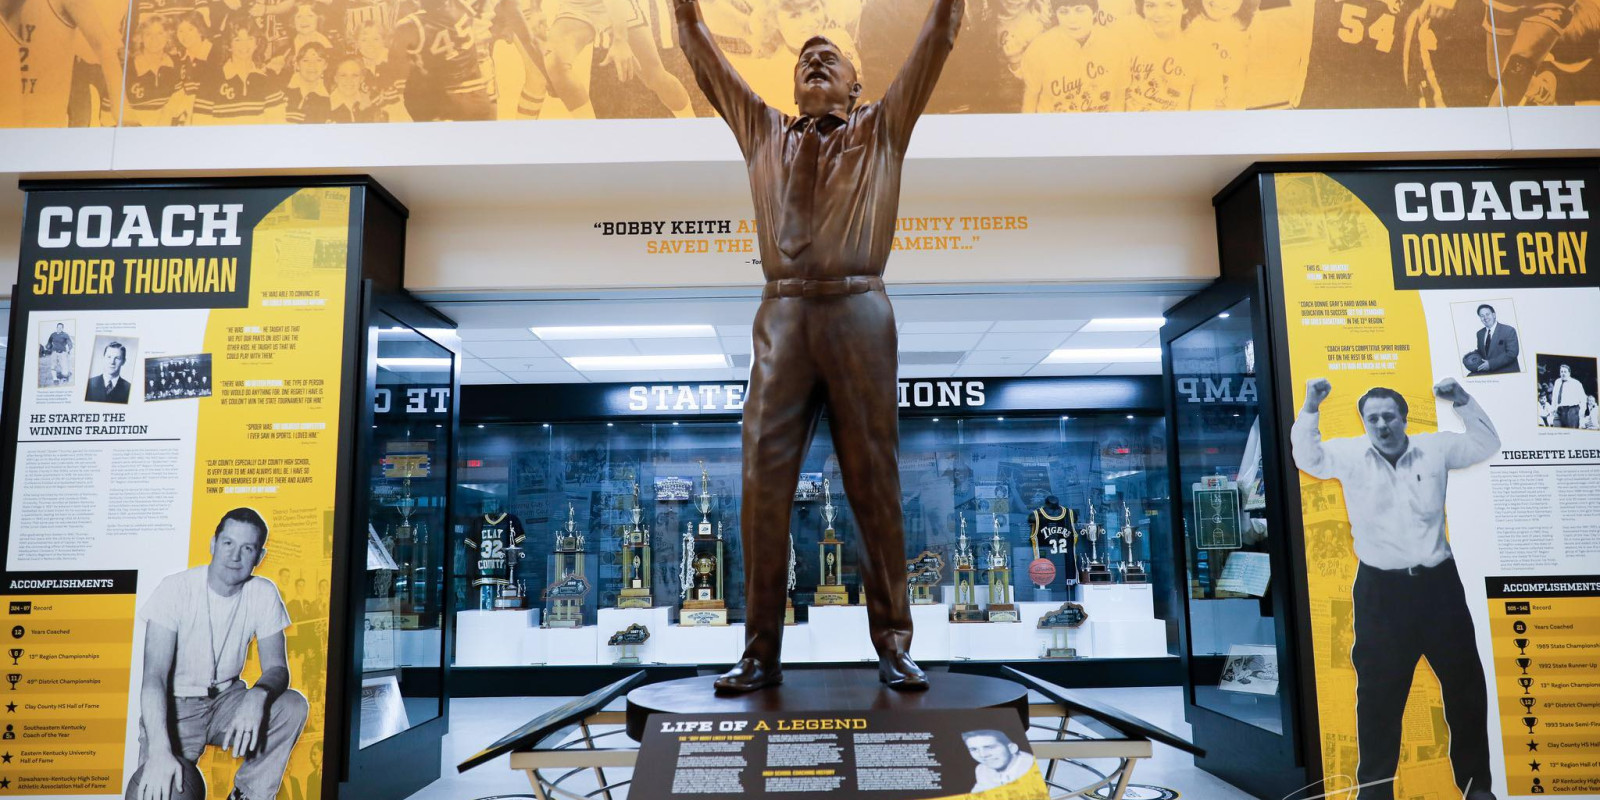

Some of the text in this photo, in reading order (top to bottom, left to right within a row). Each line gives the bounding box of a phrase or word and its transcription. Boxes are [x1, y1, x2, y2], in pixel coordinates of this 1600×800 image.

[431, 14, 474, 60] 45
[1338, 3, 1395, 53] 54
[1051, 77, 1082, 96] Clay
[1395, 180, 1589, 221] COACH
[37, 204, 243, 248] COACH
[594, 222, 665, 235] “BOBBY
[671, 220, 731, 234] KEITH
[960, 216, 1028, 230] TIGERS
[647, 240, 709, 253] SAVED
[715, 239, 753, 252] THE
[1402, 231, 1588, 276] DONNIE GRAY
[33, 258, 237, 294] SPIDER THURMAN
[629, 384, 743, 411] STATE
[30, 413, 126, 423] HE STARTED THE
[30, 425, 148, 435] WINNING TRADITION
[1502, 450, 1566, 460] TIGERETTE
[482, 529, 503, 539] CLAY
[1041, 526, 1071, 539] TIGERS
[481, 540, 504, 558] 32
[1049, 538, 1067, 554] 32
[10, 579, 114, 589] ACCOMPLISHMENTS
[660, 718, 868, 733] LIFE OF A LEGEND
